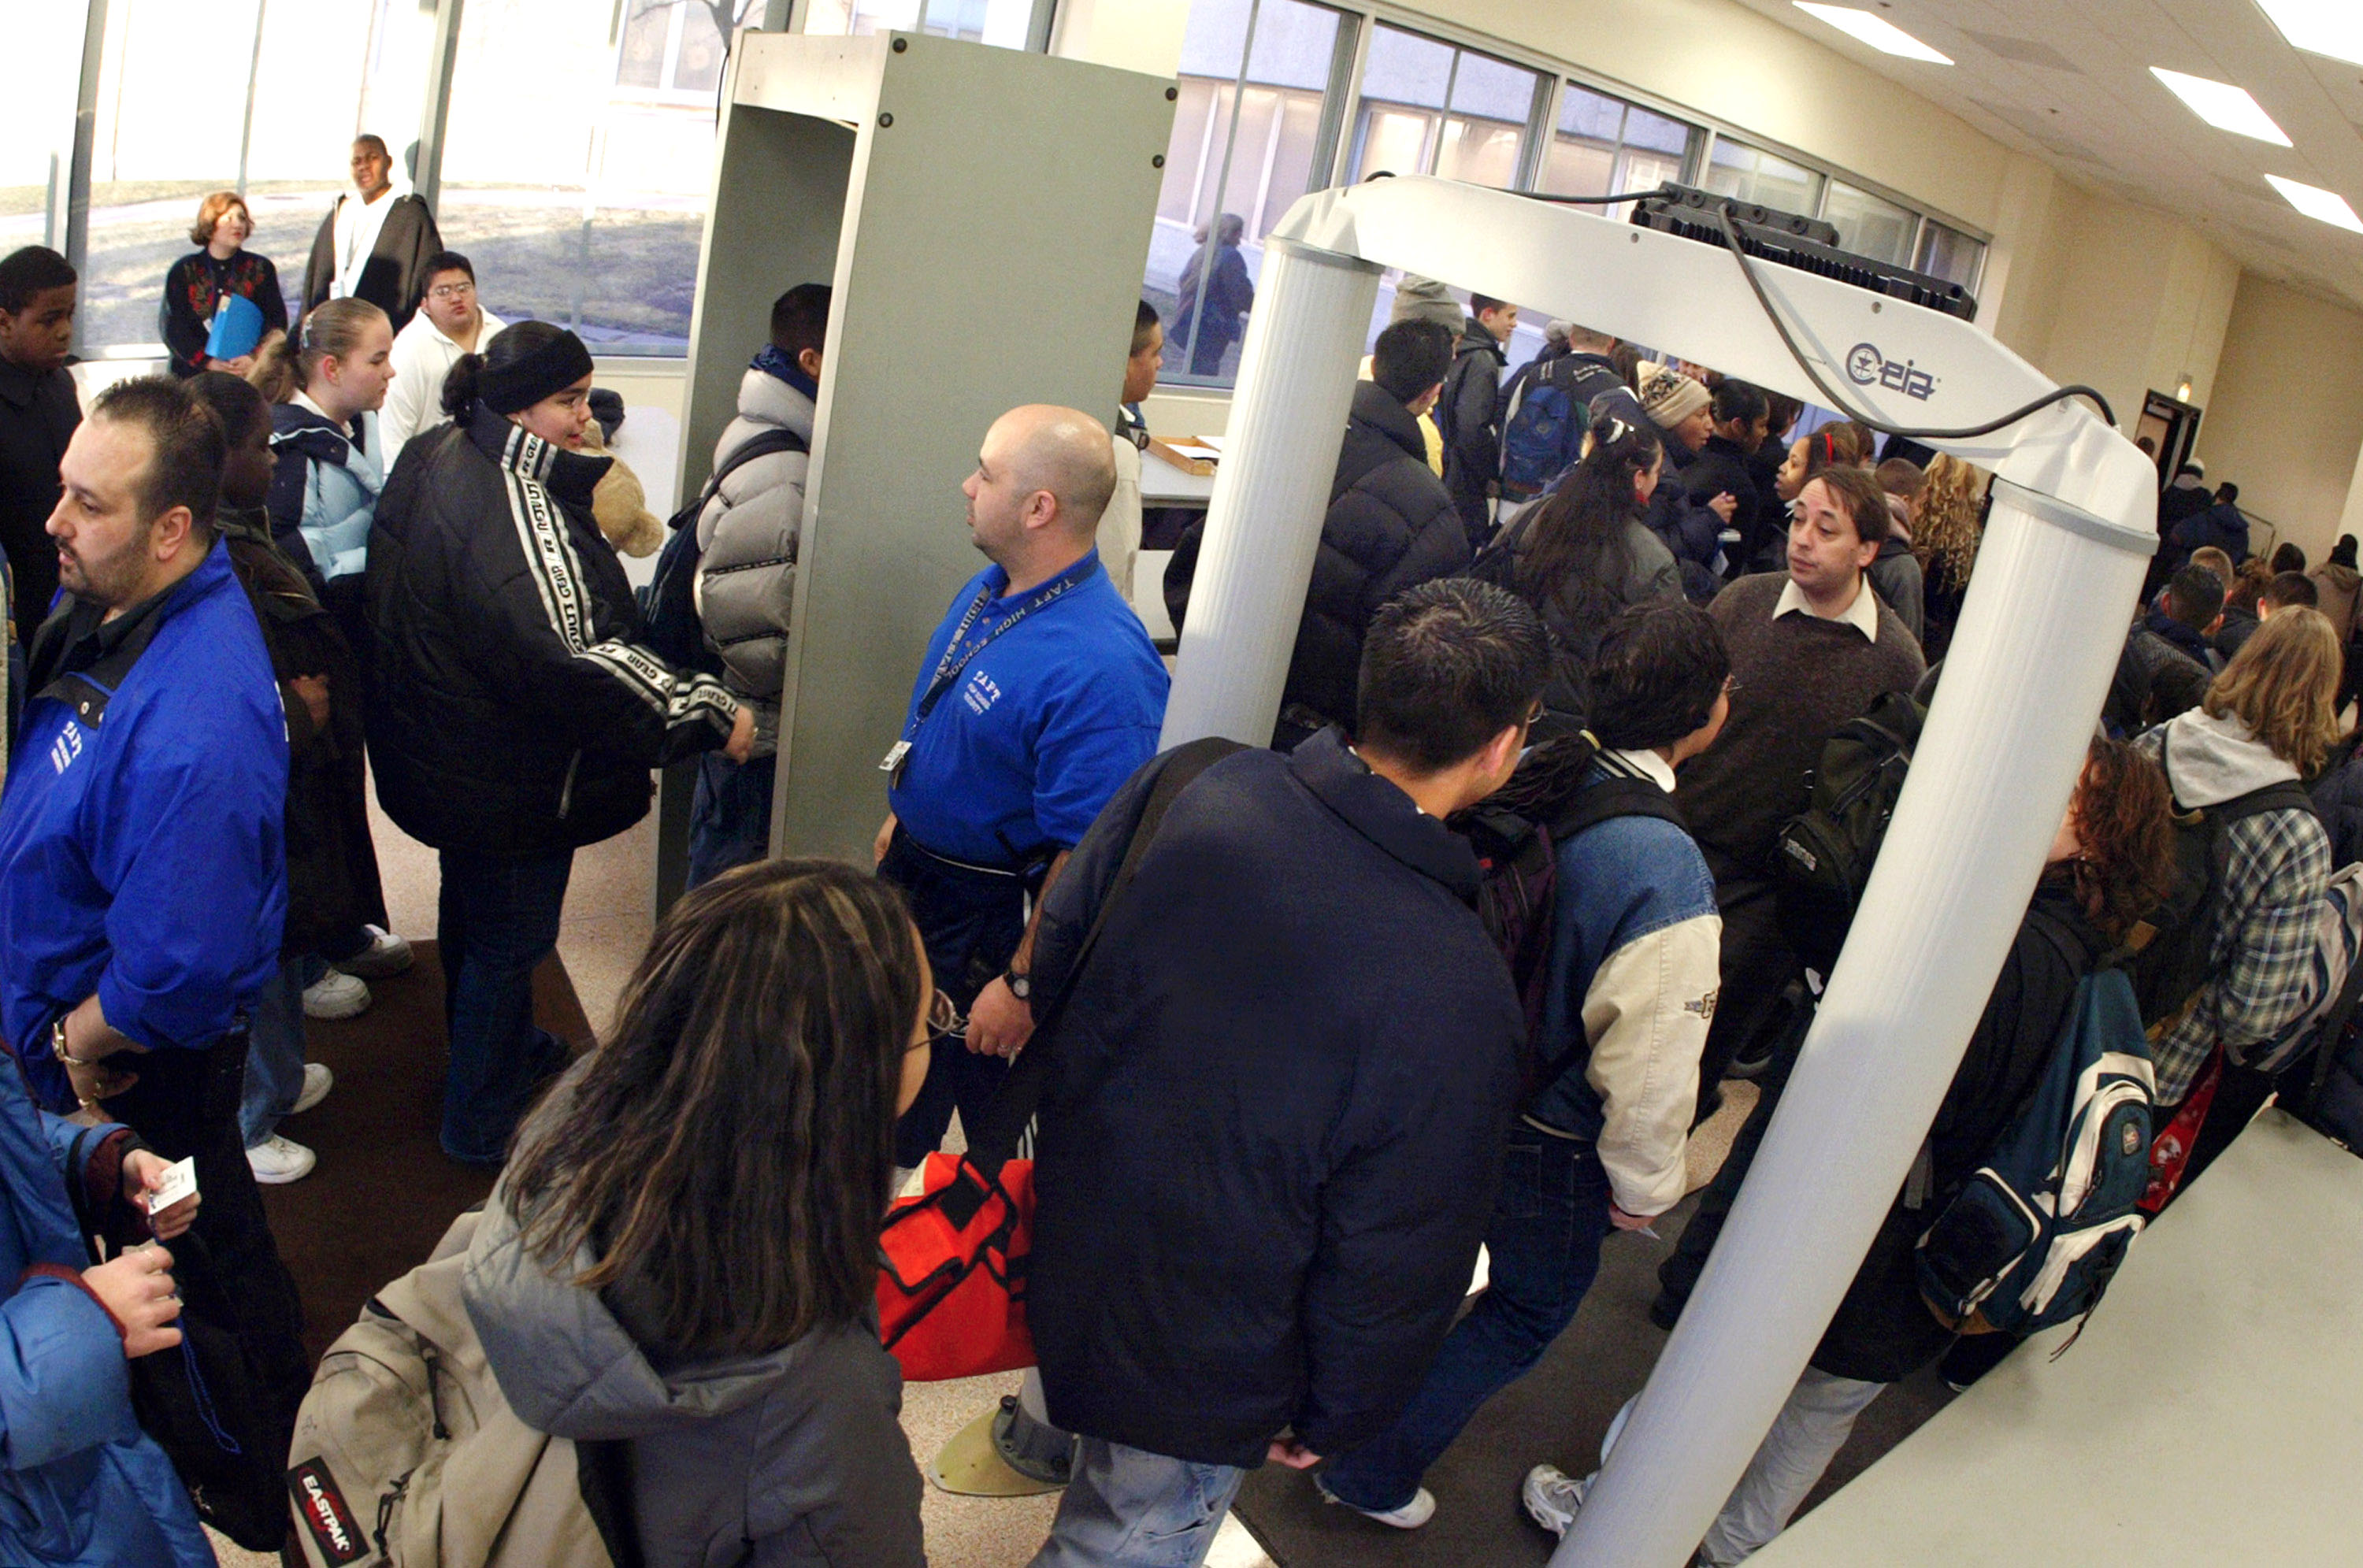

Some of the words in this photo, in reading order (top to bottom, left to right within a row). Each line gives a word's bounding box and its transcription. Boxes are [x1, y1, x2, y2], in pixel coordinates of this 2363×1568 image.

[1034, 579, 1074, 608] TAFT
[994, 607, 1026, 636] HIGH
[302, 1474, 350, 1551] EASTPAK
